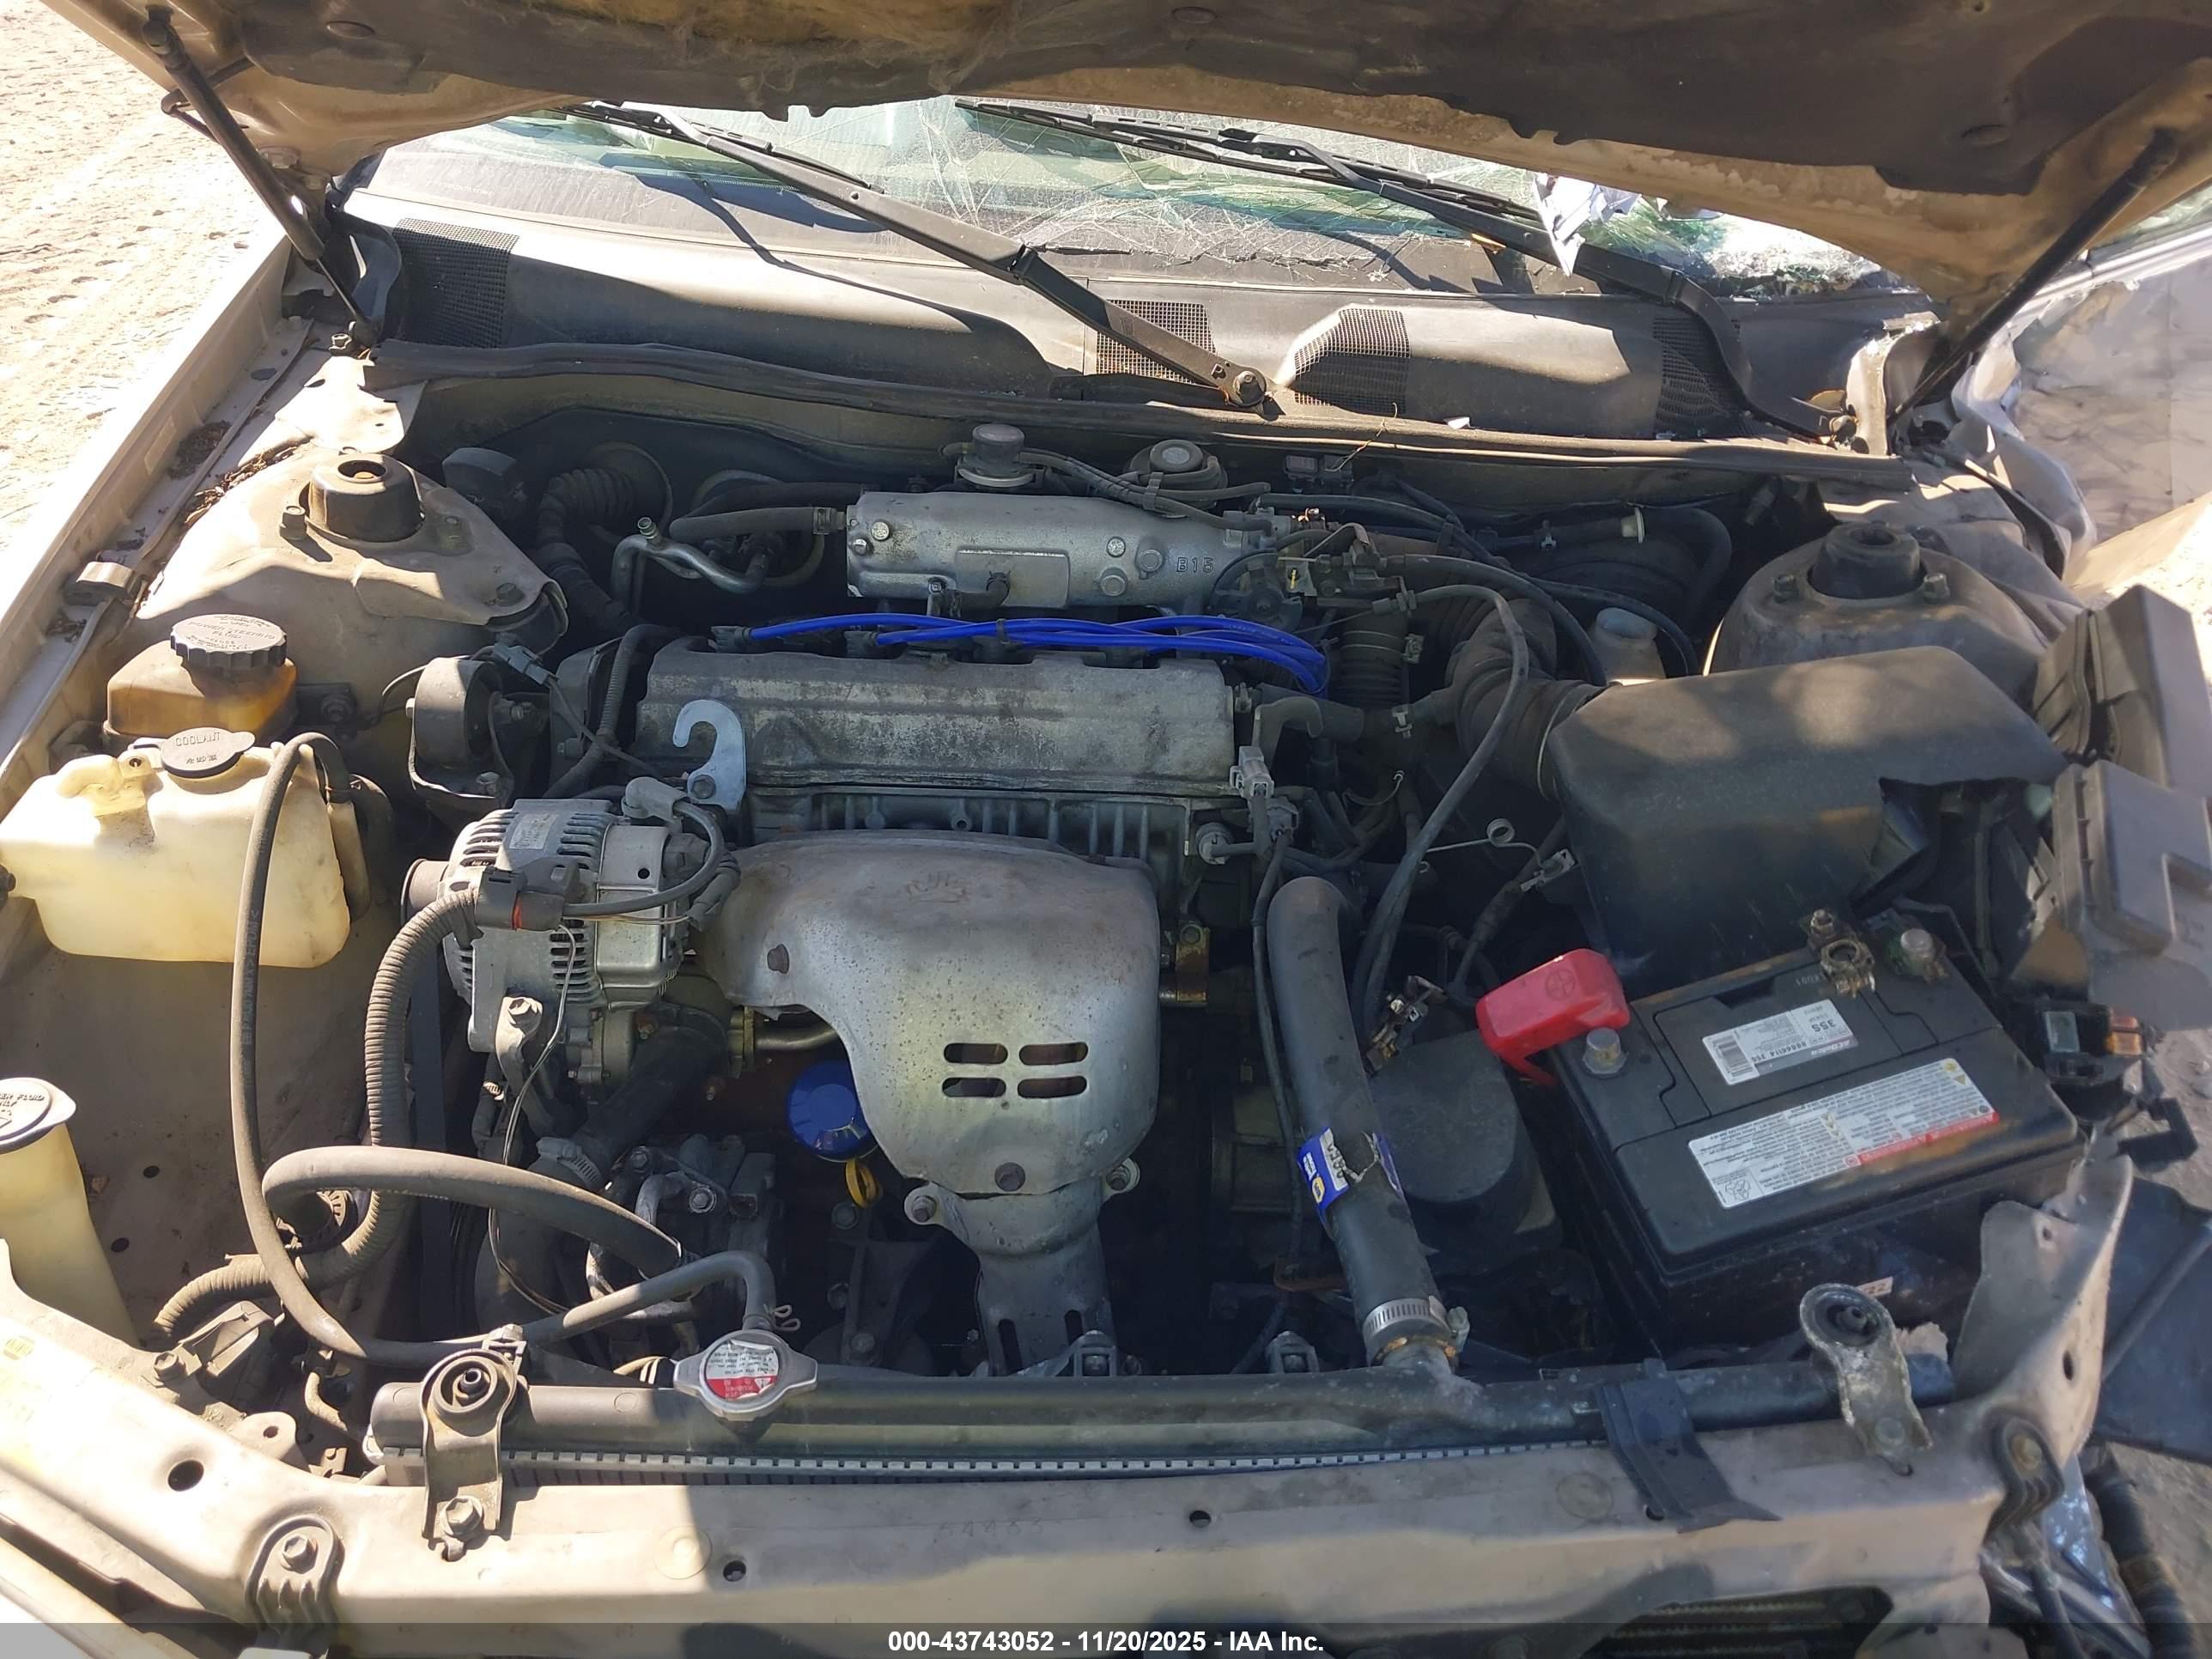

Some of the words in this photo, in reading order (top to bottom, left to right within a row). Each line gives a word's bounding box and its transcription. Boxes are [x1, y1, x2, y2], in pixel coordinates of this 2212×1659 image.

[1176, 556, 1214, 574] B15
[175, 732, 221, 746] COOLANT
[1811, 1018, 1837, 1033] 35S
